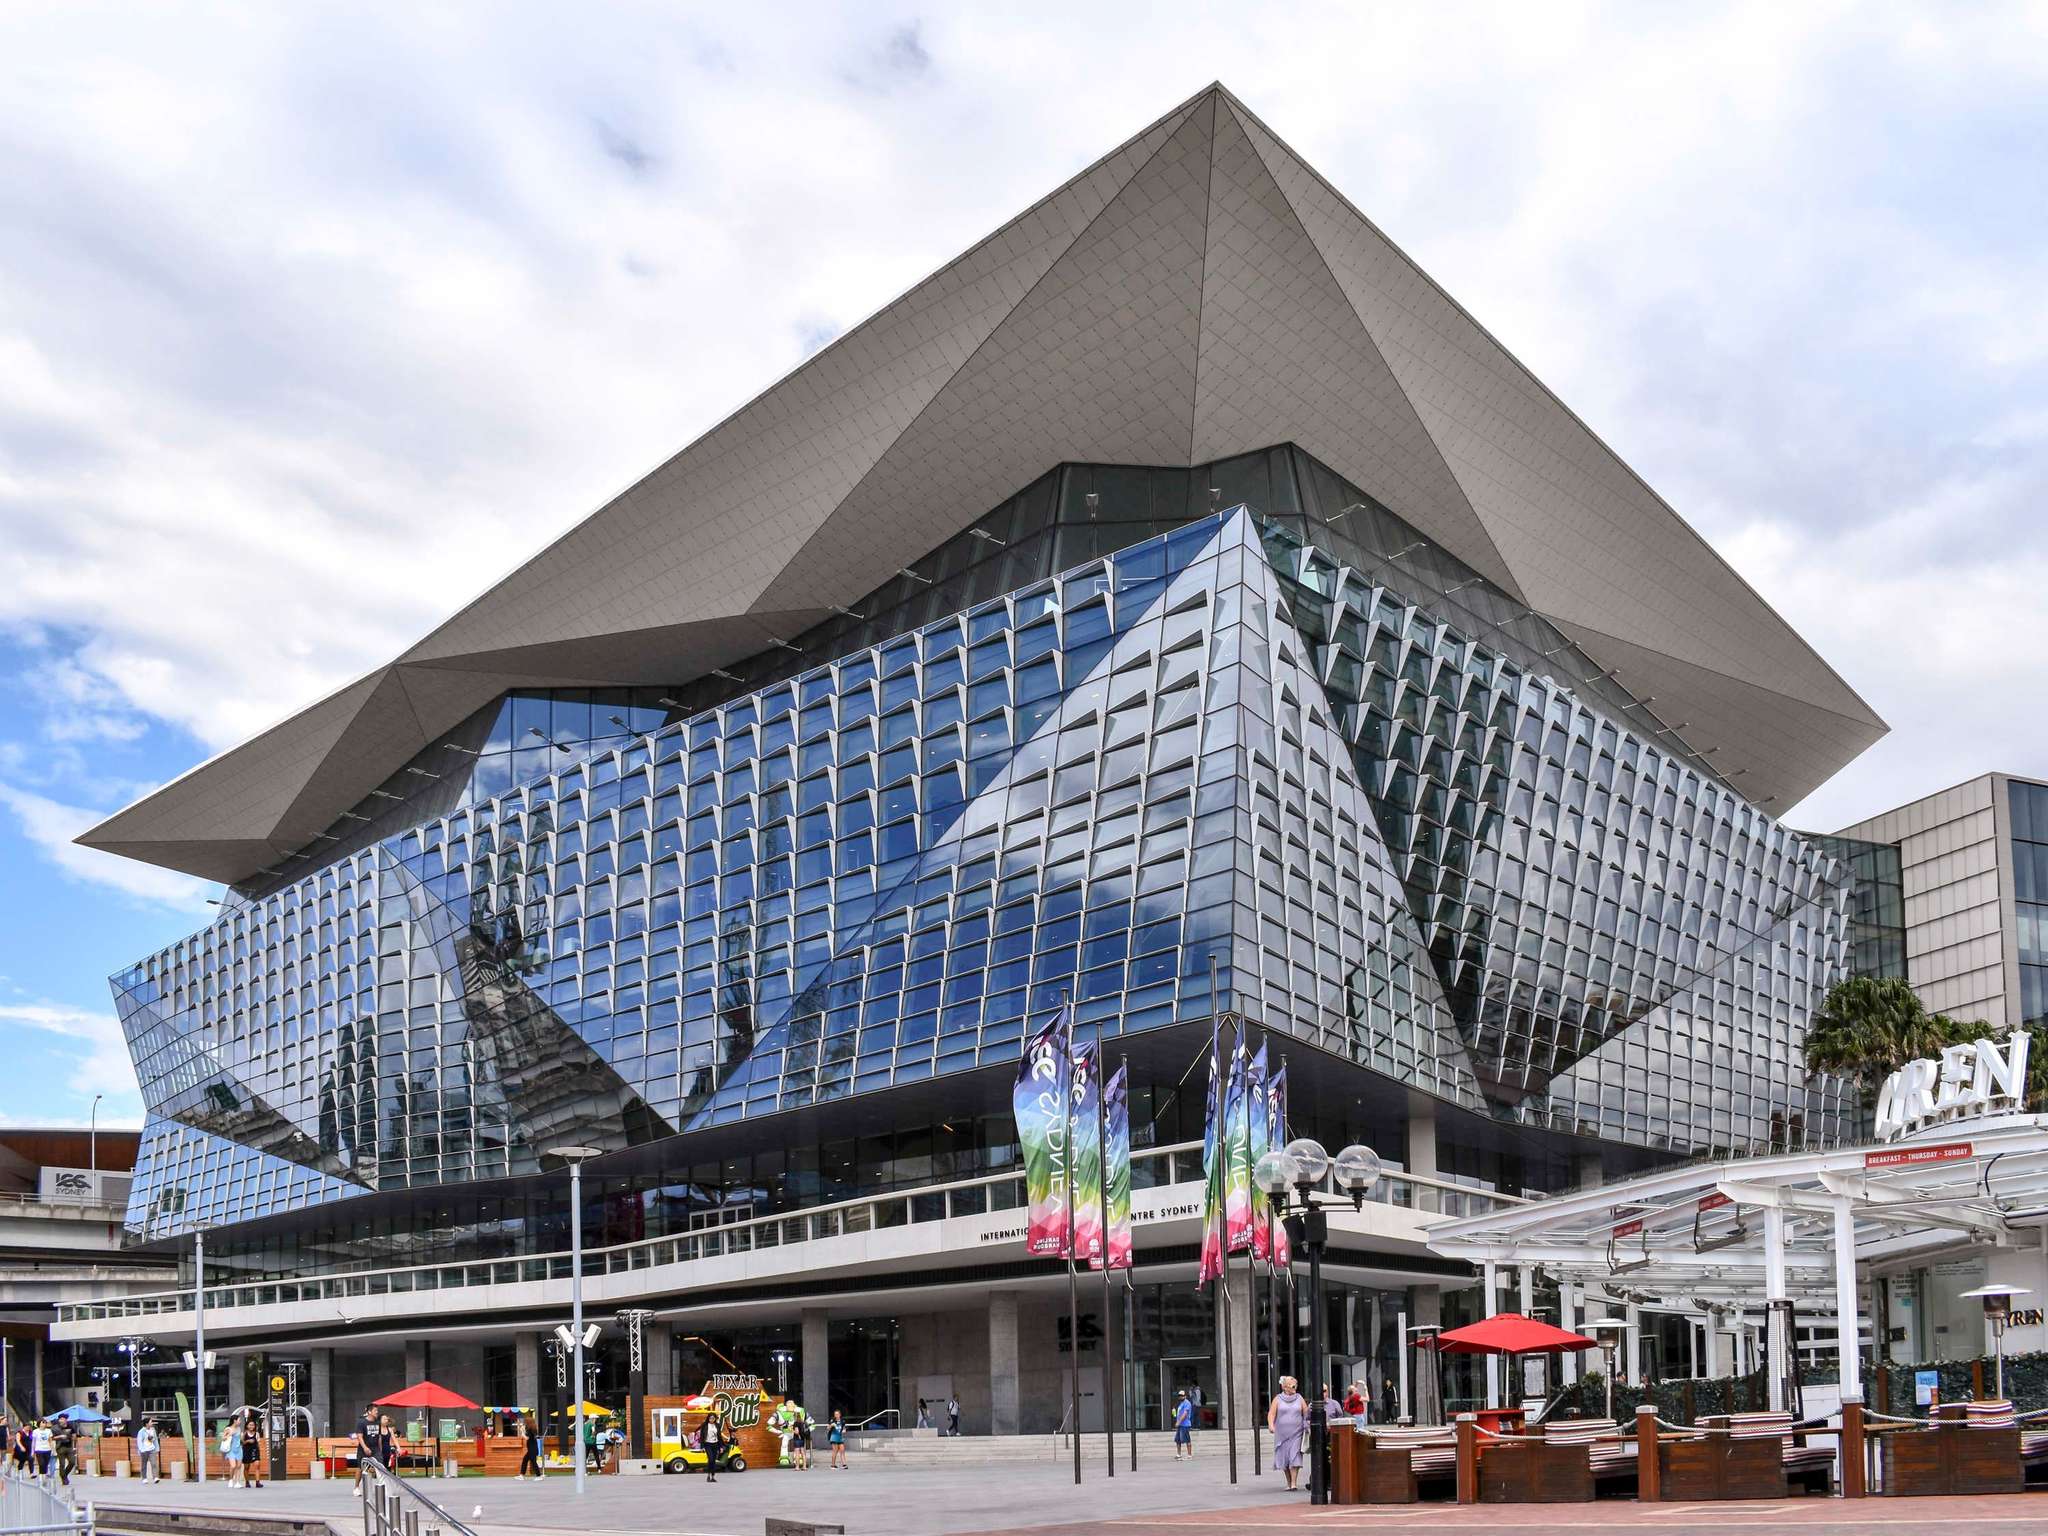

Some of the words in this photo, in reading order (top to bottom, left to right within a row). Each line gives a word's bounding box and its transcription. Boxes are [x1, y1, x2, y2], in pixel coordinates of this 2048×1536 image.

[1868, 1154, 1901, 1164] BREAKFAST
[1908, 1151, 1938, 1160] THURSDAY
[1944, 1148, 1968, 1157] SUNDAY
[981, 1227, 1029, 1241] INTERNATIO
[1131, 1210, 1155, 1221] NTRE
[1161, 1204, 1199, 1216] SYDNEY
[2005, 1308, 2043, 1328] YREN
[712, 1374, 758, 1390] PIXAR
[712, 1392, 760, 1431] Putt
